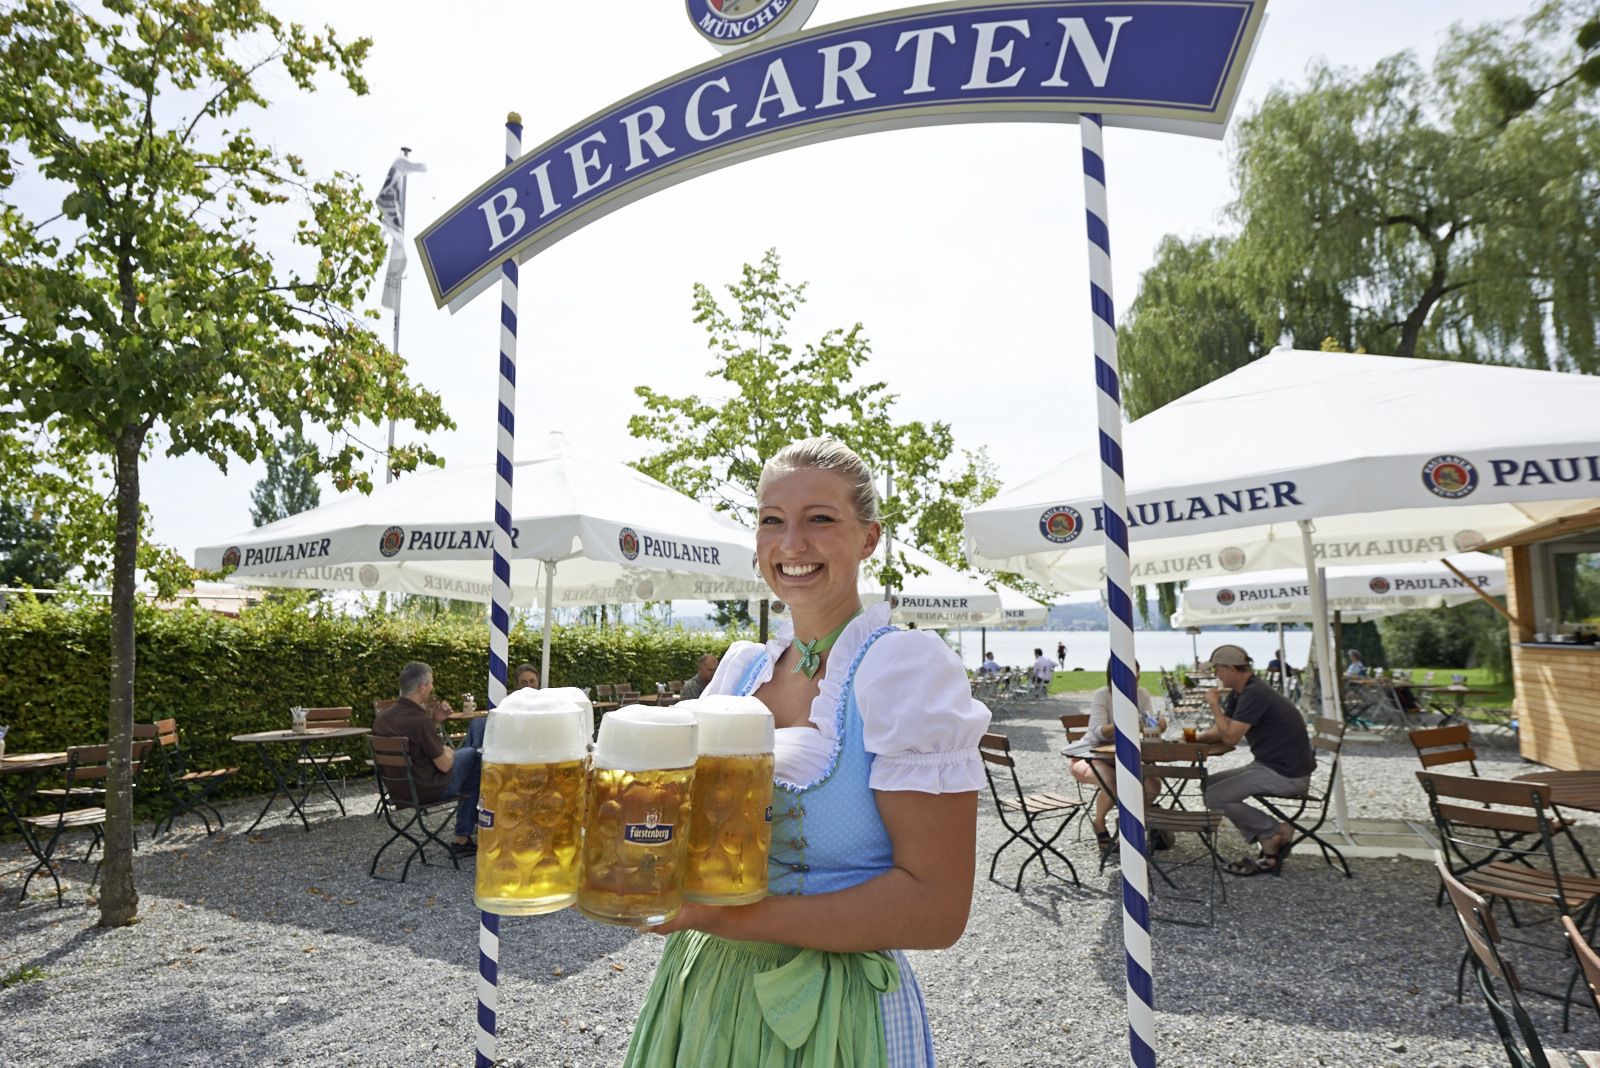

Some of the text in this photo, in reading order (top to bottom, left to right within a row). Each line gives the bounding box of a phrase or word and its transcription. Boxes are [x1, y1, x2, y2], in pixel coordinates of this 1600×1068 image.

[477, 15, 1133, 252] BIERGARTEN
[407, 527, 519, 551] PAULANR
[643, 535, 721, 566] PAULANER
[243, 537, 331, 567] PAULANER
[1394, 575, 1490, 591] PAULANR
[902, 597, 968, 609] PAULANER
[630, 826, 669, 840] Fürstenberg
